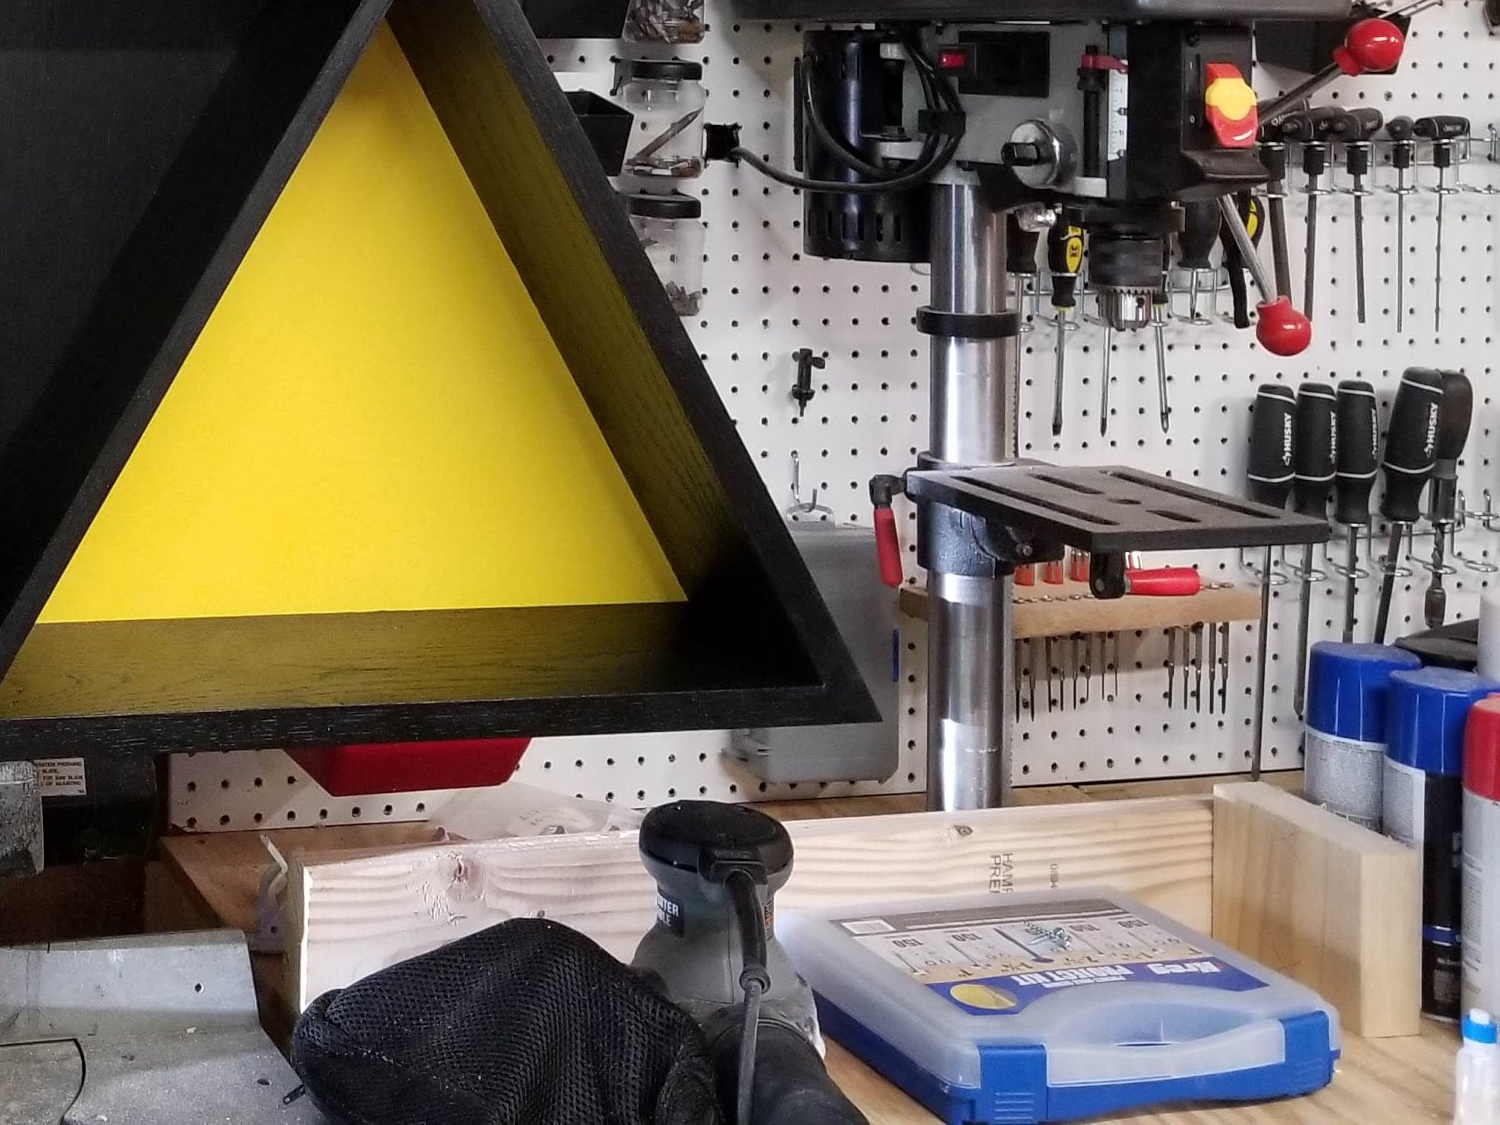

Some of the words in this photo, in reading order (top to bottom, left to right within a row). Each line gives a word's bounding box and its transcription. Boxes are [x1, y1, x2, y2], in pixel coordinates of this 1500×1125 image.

[1283, 412, 1293, 452] HUSKY
[1329, 411, 1337, 450] HUSKY
[1427, 402, 1439, 445] HUSKY
[891, 938, 924, 948] 150
[951, 933, 983, 942] 150
[1045, 964, 1134, 981] PROJECT
[1147, 962, 1222, 975] Kreg
